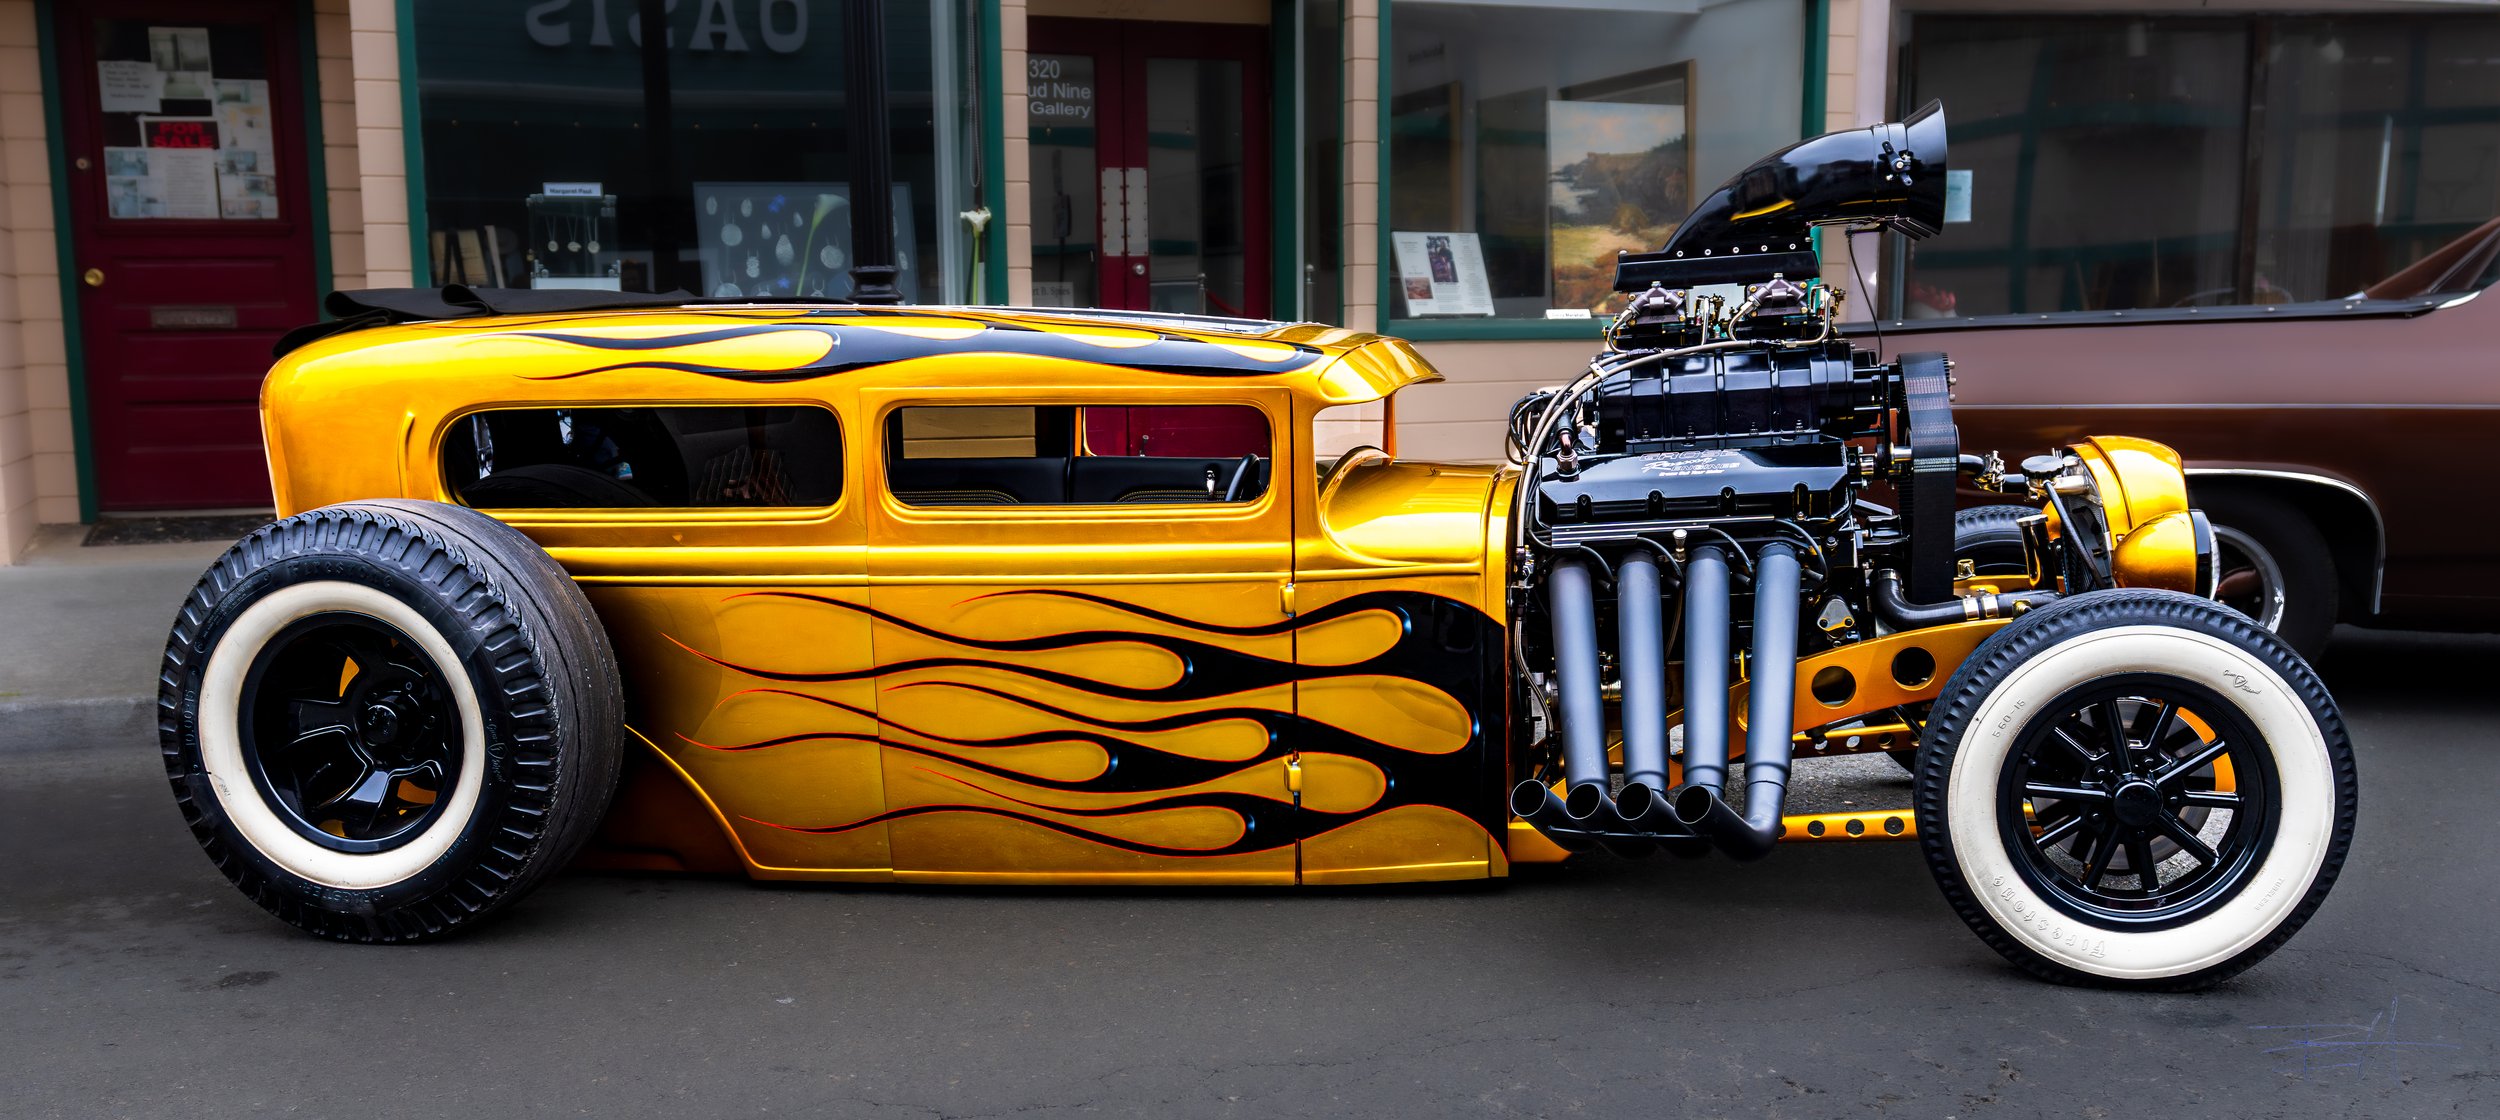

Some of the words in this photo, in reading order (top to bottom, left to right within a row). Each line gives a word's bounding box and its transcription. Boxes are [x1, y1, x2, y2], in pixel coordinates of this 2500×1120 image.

[1028, 59, 1060, 79] 320
[1028, 82, 1048, 98] ud
[1053, 82, 1092, 99] Nine
[1030, 101, 1091, 119] Gallery
[159, 121, 204, 135] FOR
[153, 135, 215, 148] SALE
[1993, 876, 2105, 959] Firestone
